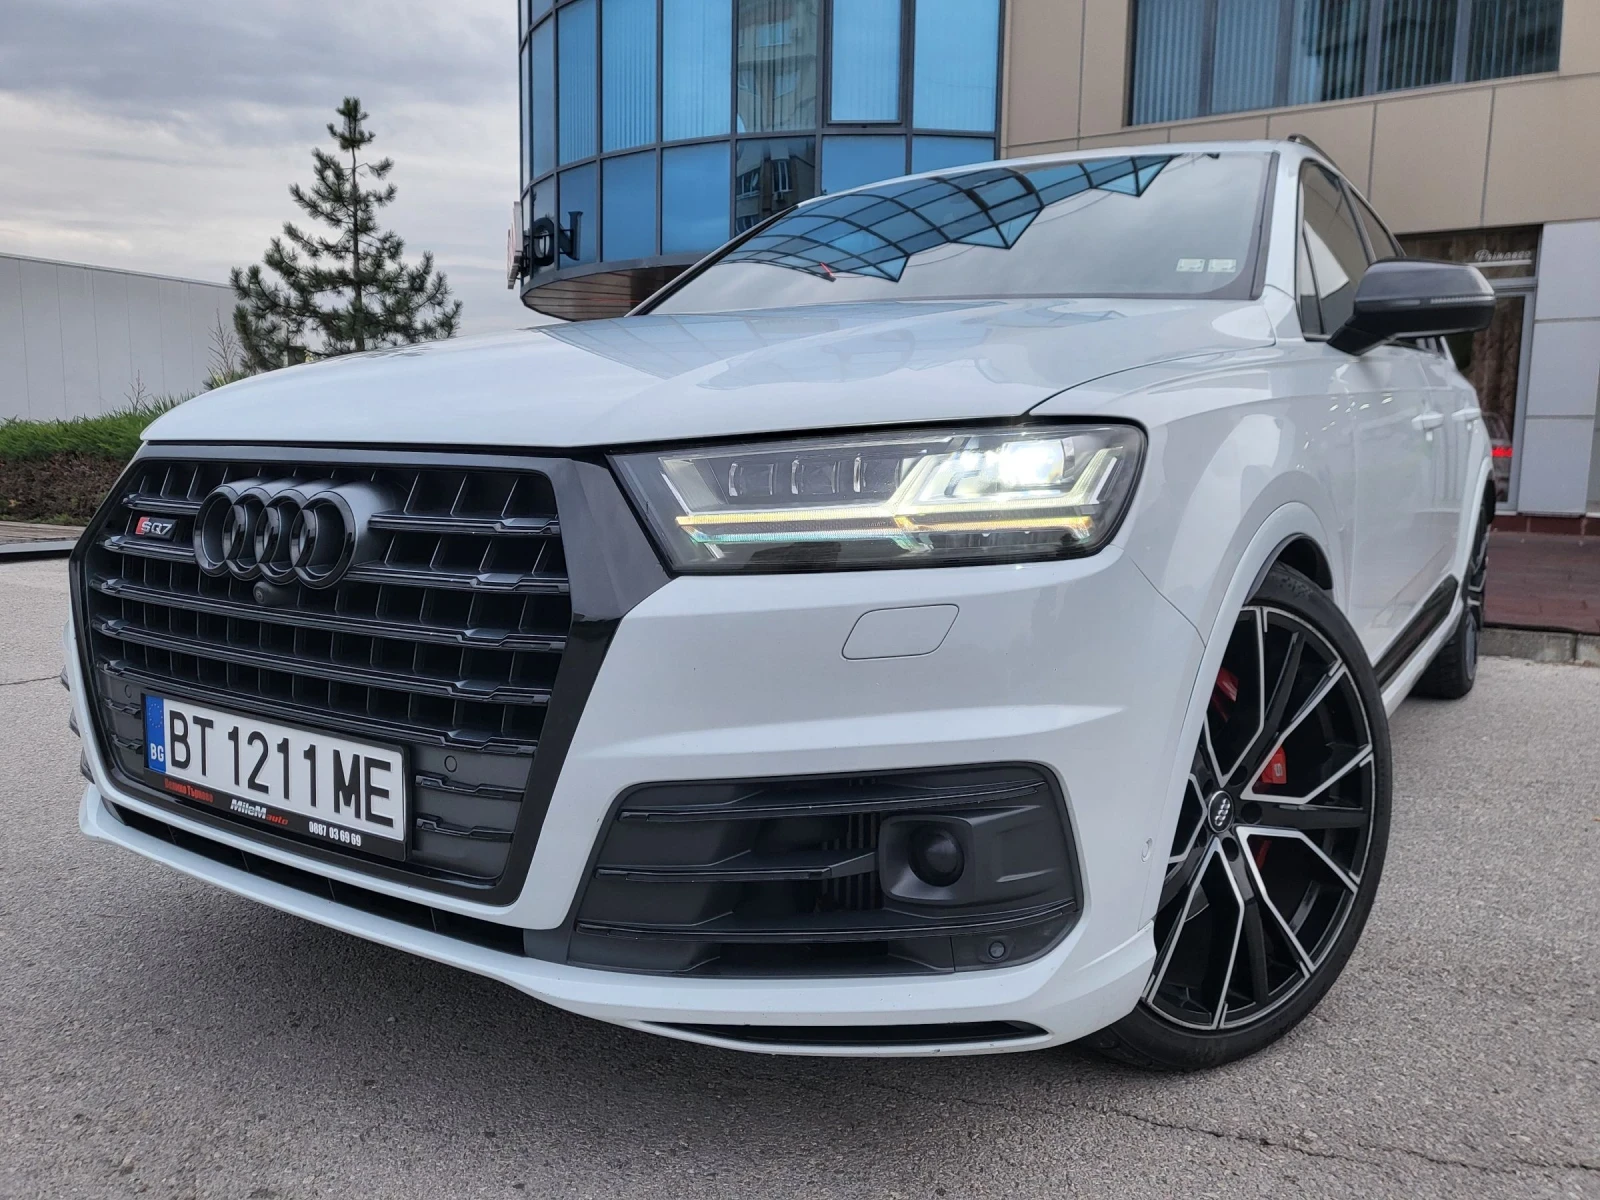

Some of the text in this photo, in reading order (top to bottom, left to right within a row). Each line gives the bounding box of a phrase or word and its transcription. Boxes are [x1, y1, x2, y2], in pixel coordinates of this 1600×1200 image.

[141, 521, 173, 535] SQ7
[150, 742, 165, 762] BG
[169, 709, 394, 828] BT 1211 ME
[308, 821, 361, 847] 0887 03 69 69
